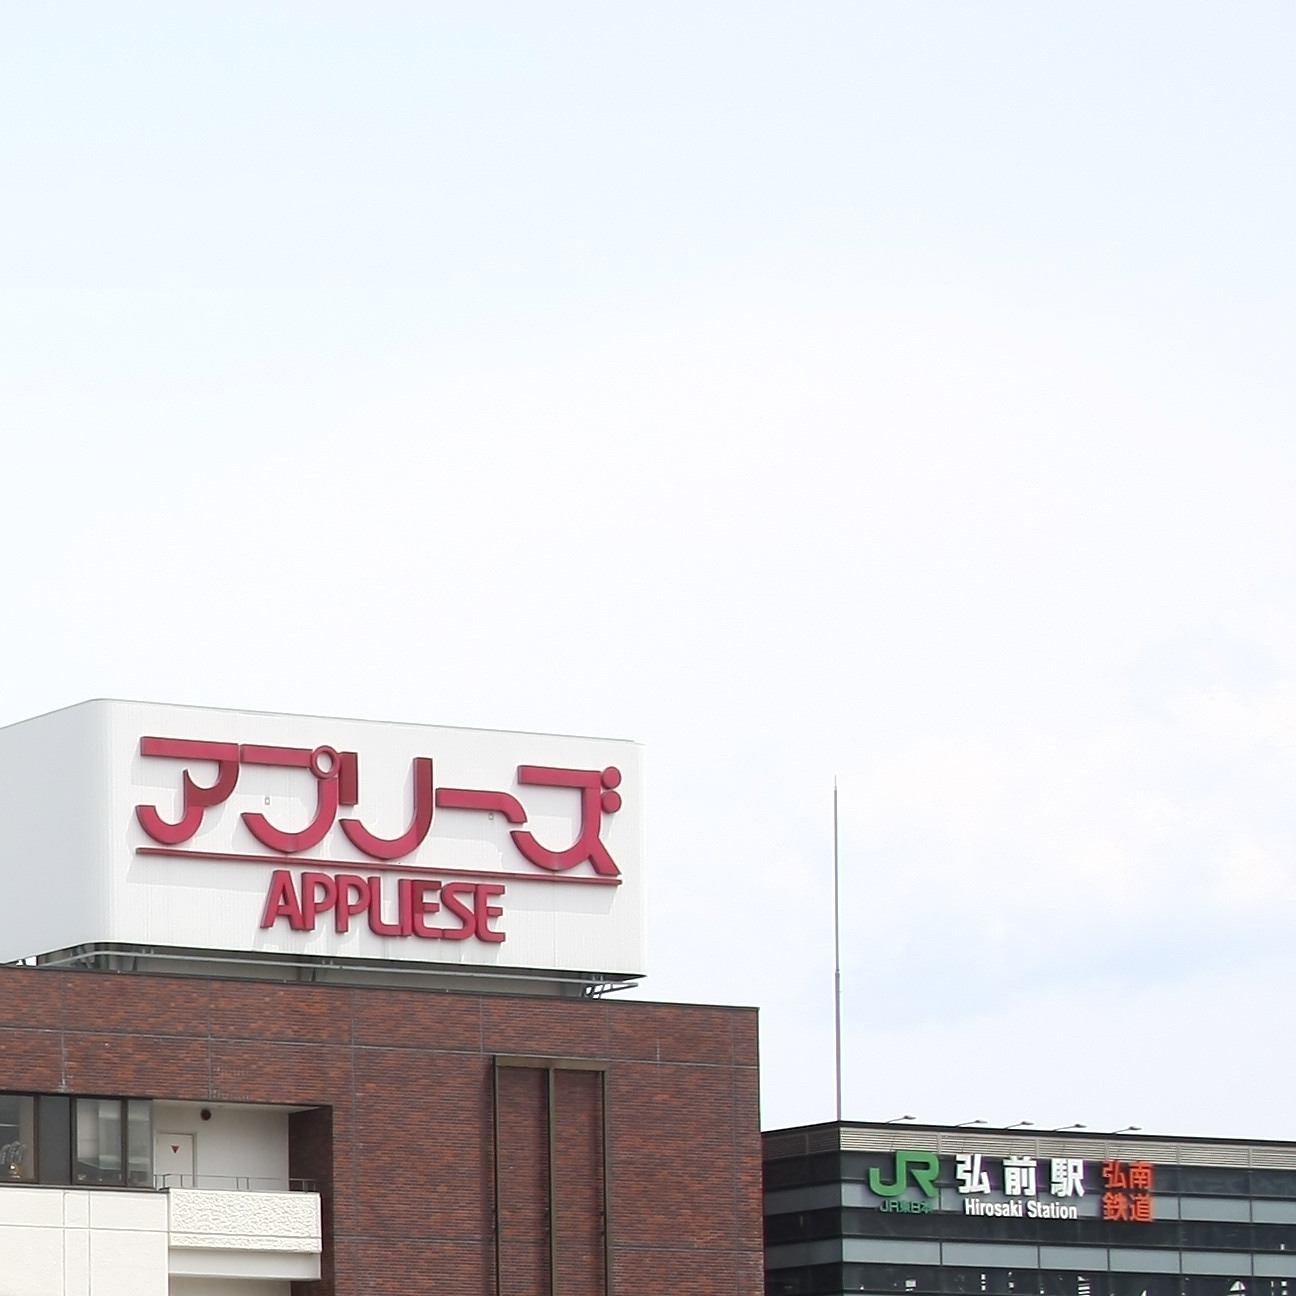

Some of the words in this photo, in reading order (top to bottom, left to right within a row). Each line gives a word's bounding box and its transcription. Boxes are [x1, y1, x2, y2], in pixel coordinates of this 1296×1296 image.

[136, 736, 623, 877] アプリーズ
[260, 869, 506, 942] APPLIESE
[869, 1149, 940, 1197] JR
[955, 1153, 1085, 1196] 弘前駅
[1102, 1160, 1154, 1190] 弘南
[964, 1198, 1023, 1218] Hirosaki
[1027, 1201, 1078, 1220] Station
[1102, 1192, 1154, 1222] 鉄道
